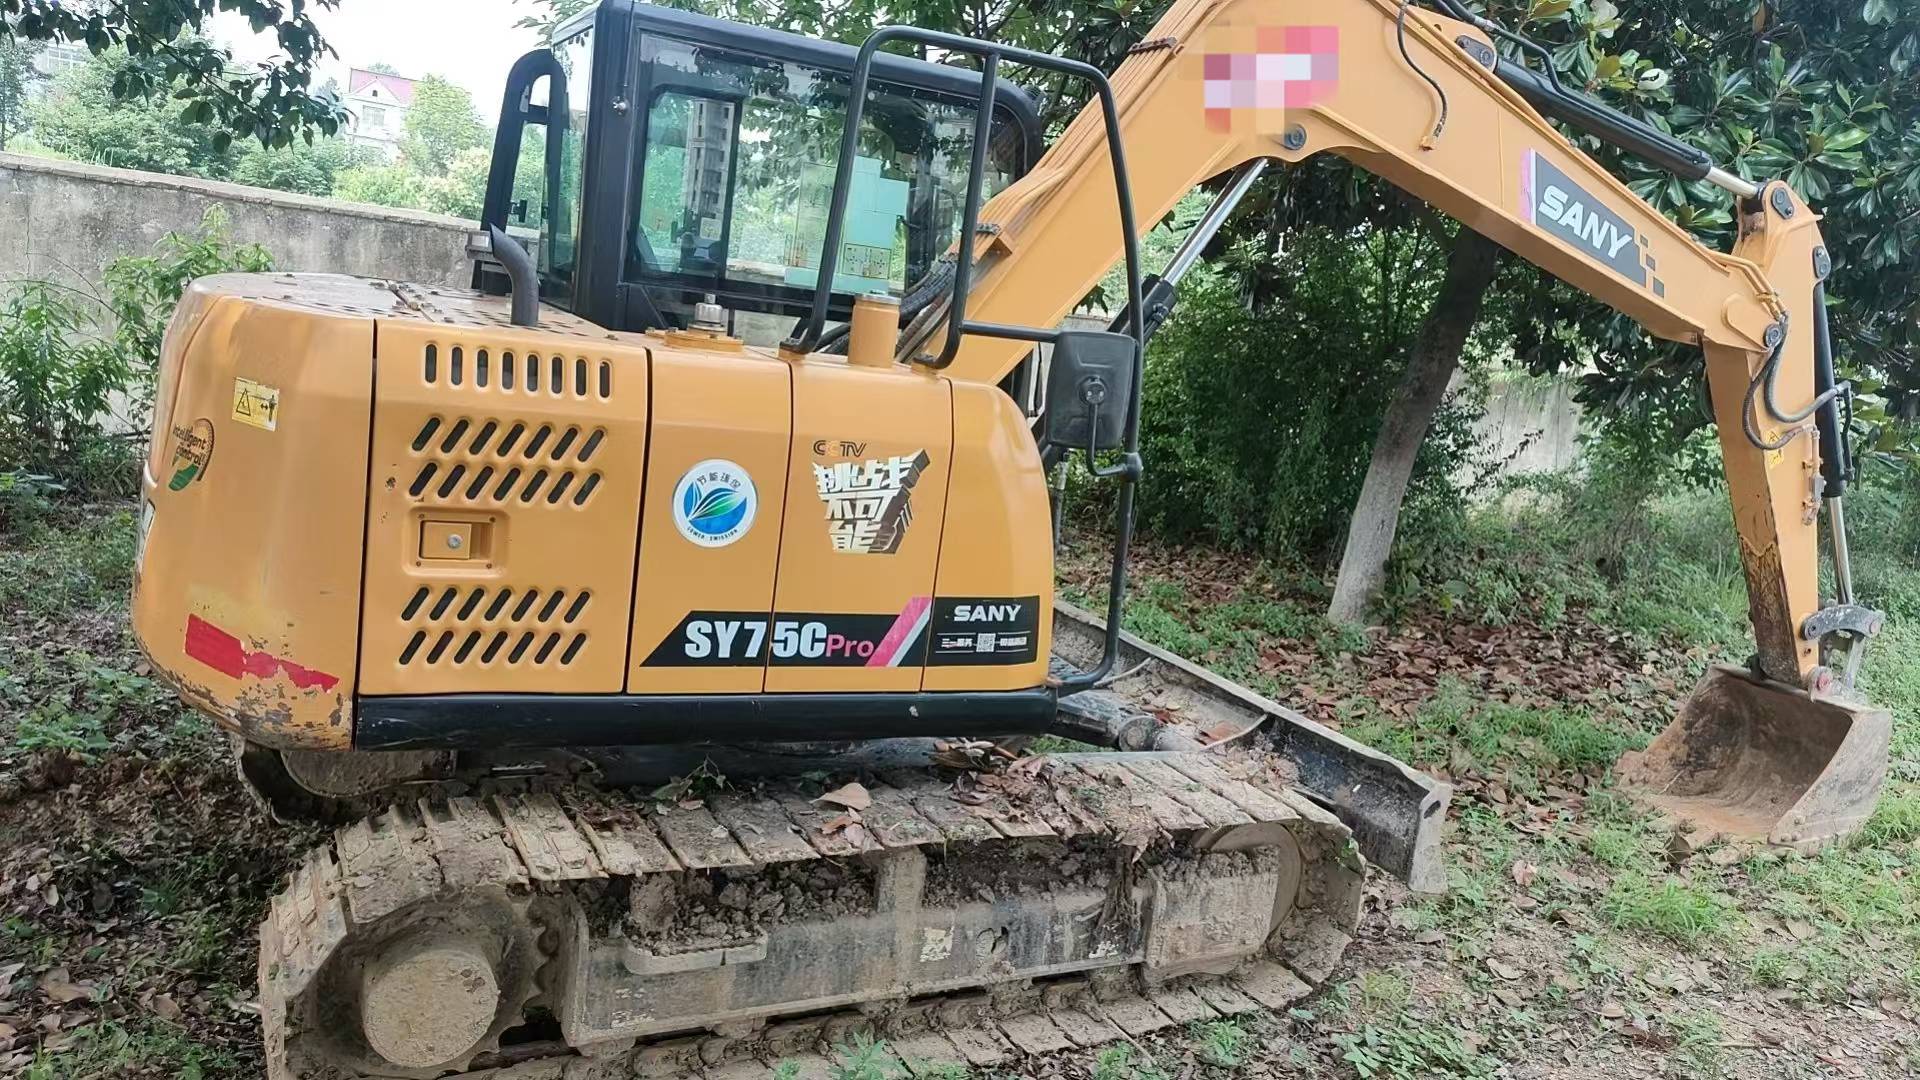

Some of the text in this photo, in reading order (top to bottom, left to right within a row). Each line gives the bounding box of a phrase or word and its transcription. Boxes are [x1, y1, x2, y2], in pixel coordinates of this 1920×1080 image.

[1538, 184, 1632, 259] SANY
[813, 440, 867, 457] CCTV
[954, 605, 1021, 622] SANY
